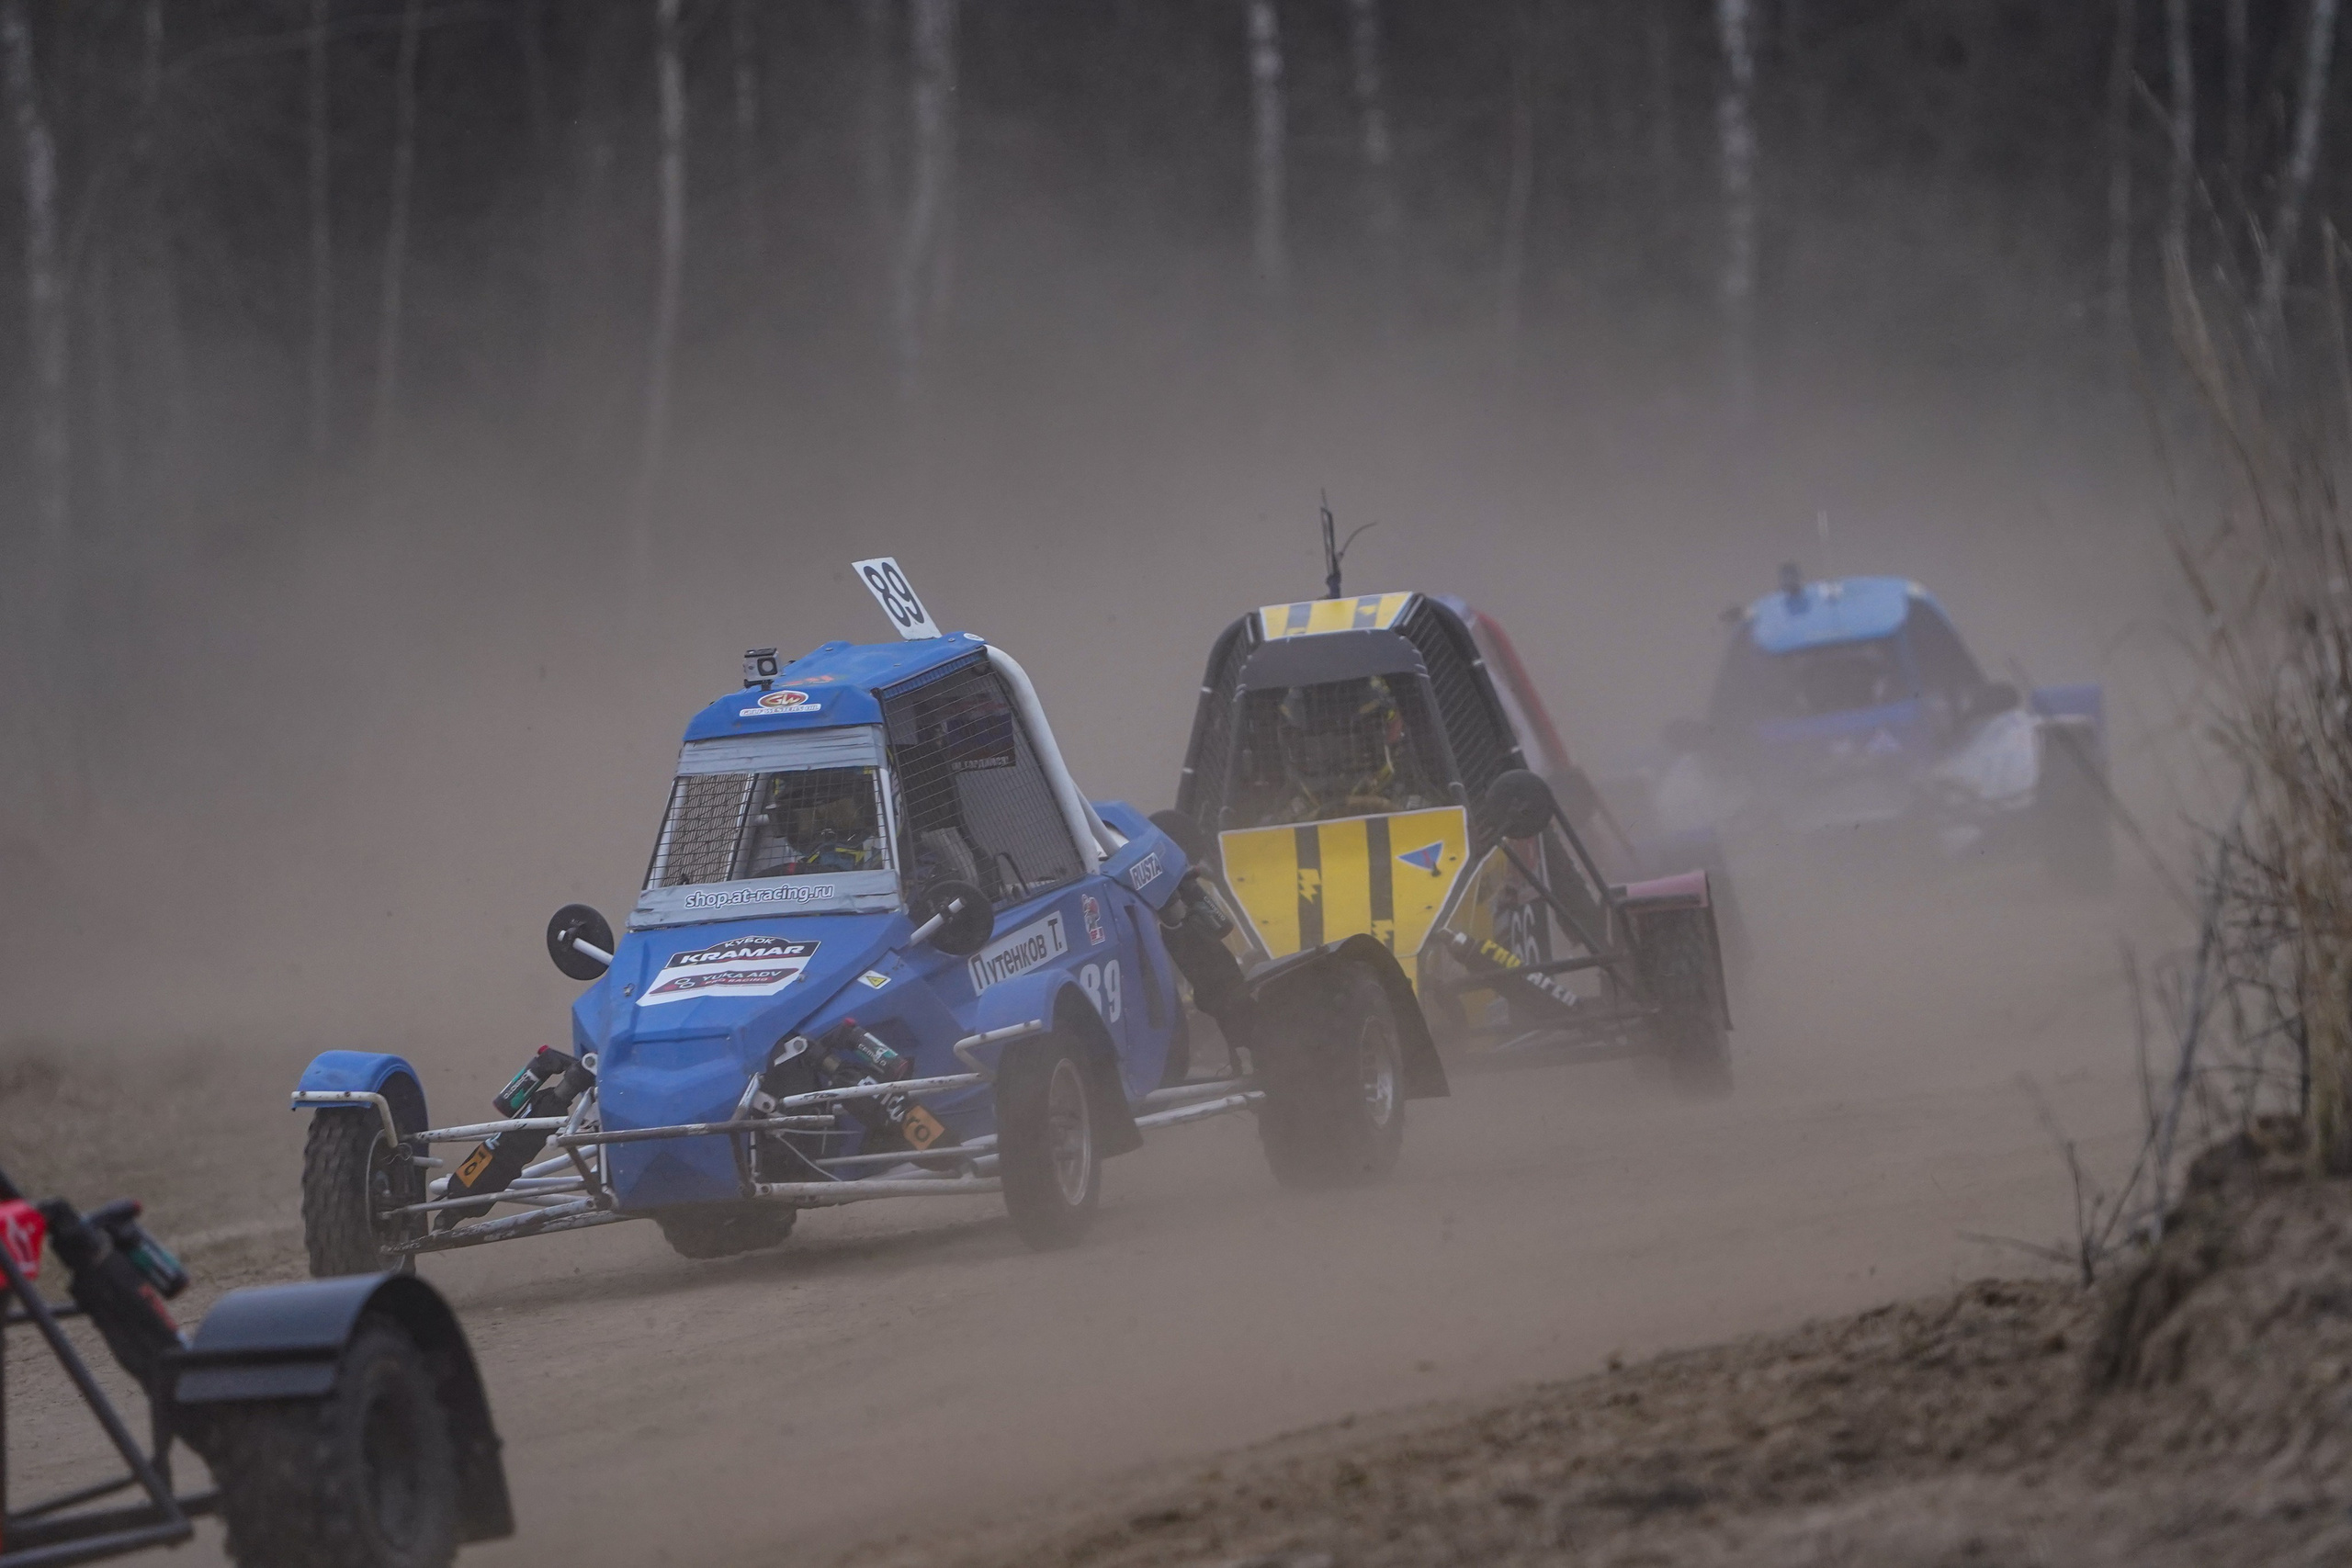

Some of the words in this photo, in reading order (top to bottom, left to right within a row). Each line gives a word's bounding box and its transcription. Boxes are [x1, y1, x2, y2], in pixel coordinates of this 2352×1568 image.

[864, 562, 924, 627] 89
[765, 694, 801, 706] GW
[684, 884, 834, 908] shop.at-racing.ru
[680, 945, 805, 964] KRAMAR
[702, 972, 743, 982] YUKA
[746, 970, 782, 978] ADV
